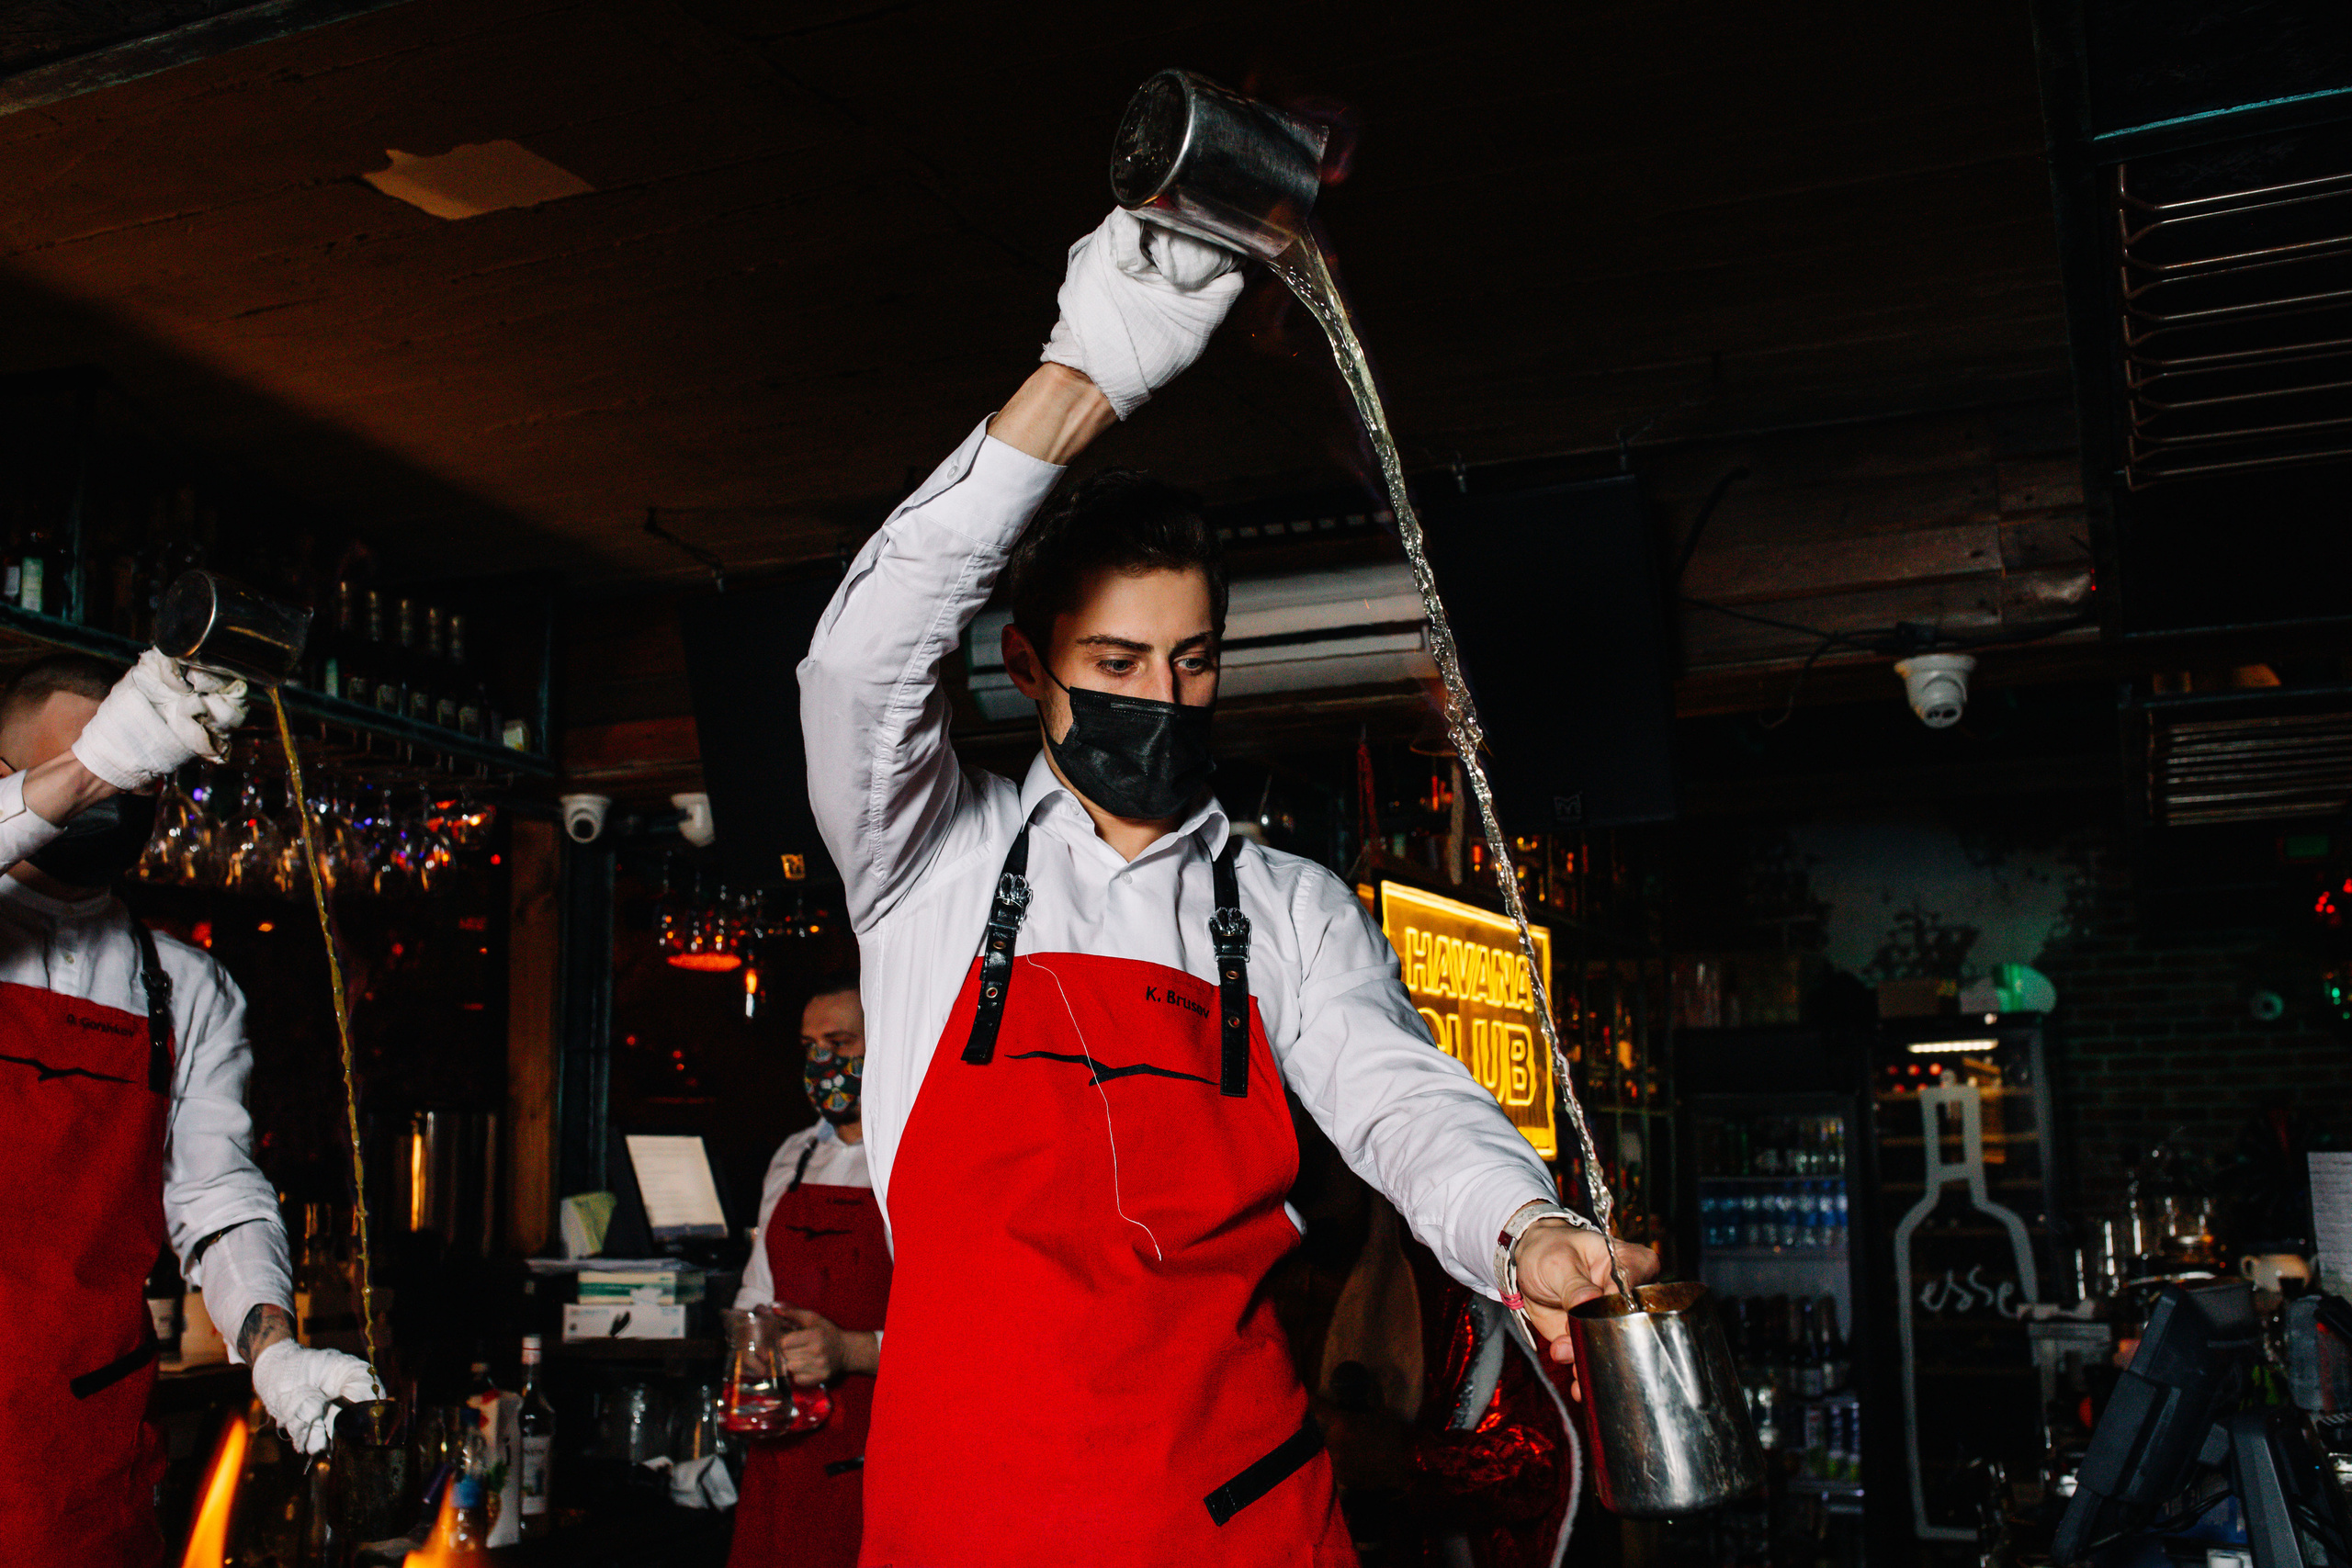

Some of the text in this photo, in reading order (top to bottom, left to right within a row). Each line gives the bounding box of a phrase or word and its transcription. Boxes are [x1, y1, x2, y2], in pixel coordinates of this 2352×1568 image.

[1405, 926, 1534, 1012] HAVANA
[1147, 986, 1210, 1019] K. Brusov
